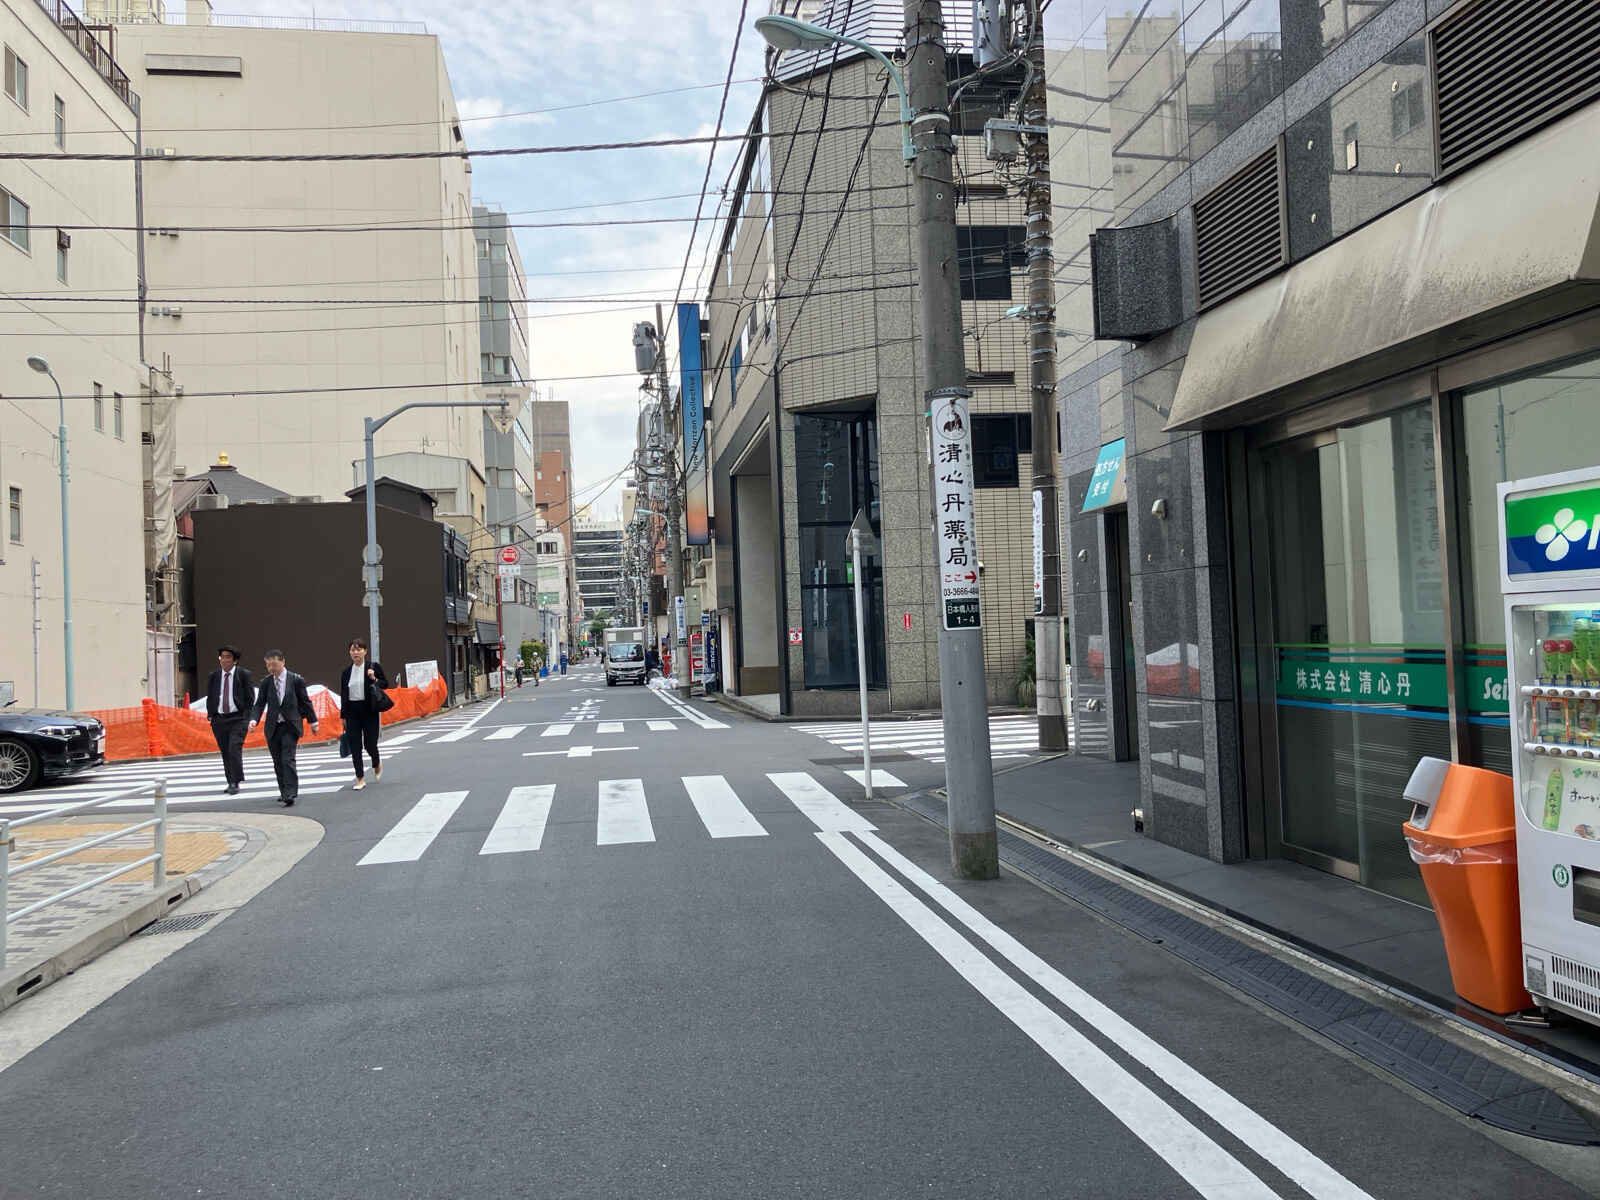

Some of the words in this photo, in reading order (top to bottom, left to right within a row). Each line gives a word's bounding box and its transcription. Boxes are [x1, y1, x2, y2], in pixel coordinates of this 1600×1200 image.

[688, 376, 697, 417] Collective
[690, 420, 698, 452] Horizon
[691, 455, 699, 473] New
[939, 443, 968, 566] 清心丹薬局
[944, 574, 962, 583] ここ
[1296, 668, 1351, 693] 株式会社
[1359, 670, 1411, 697] 清心丹
